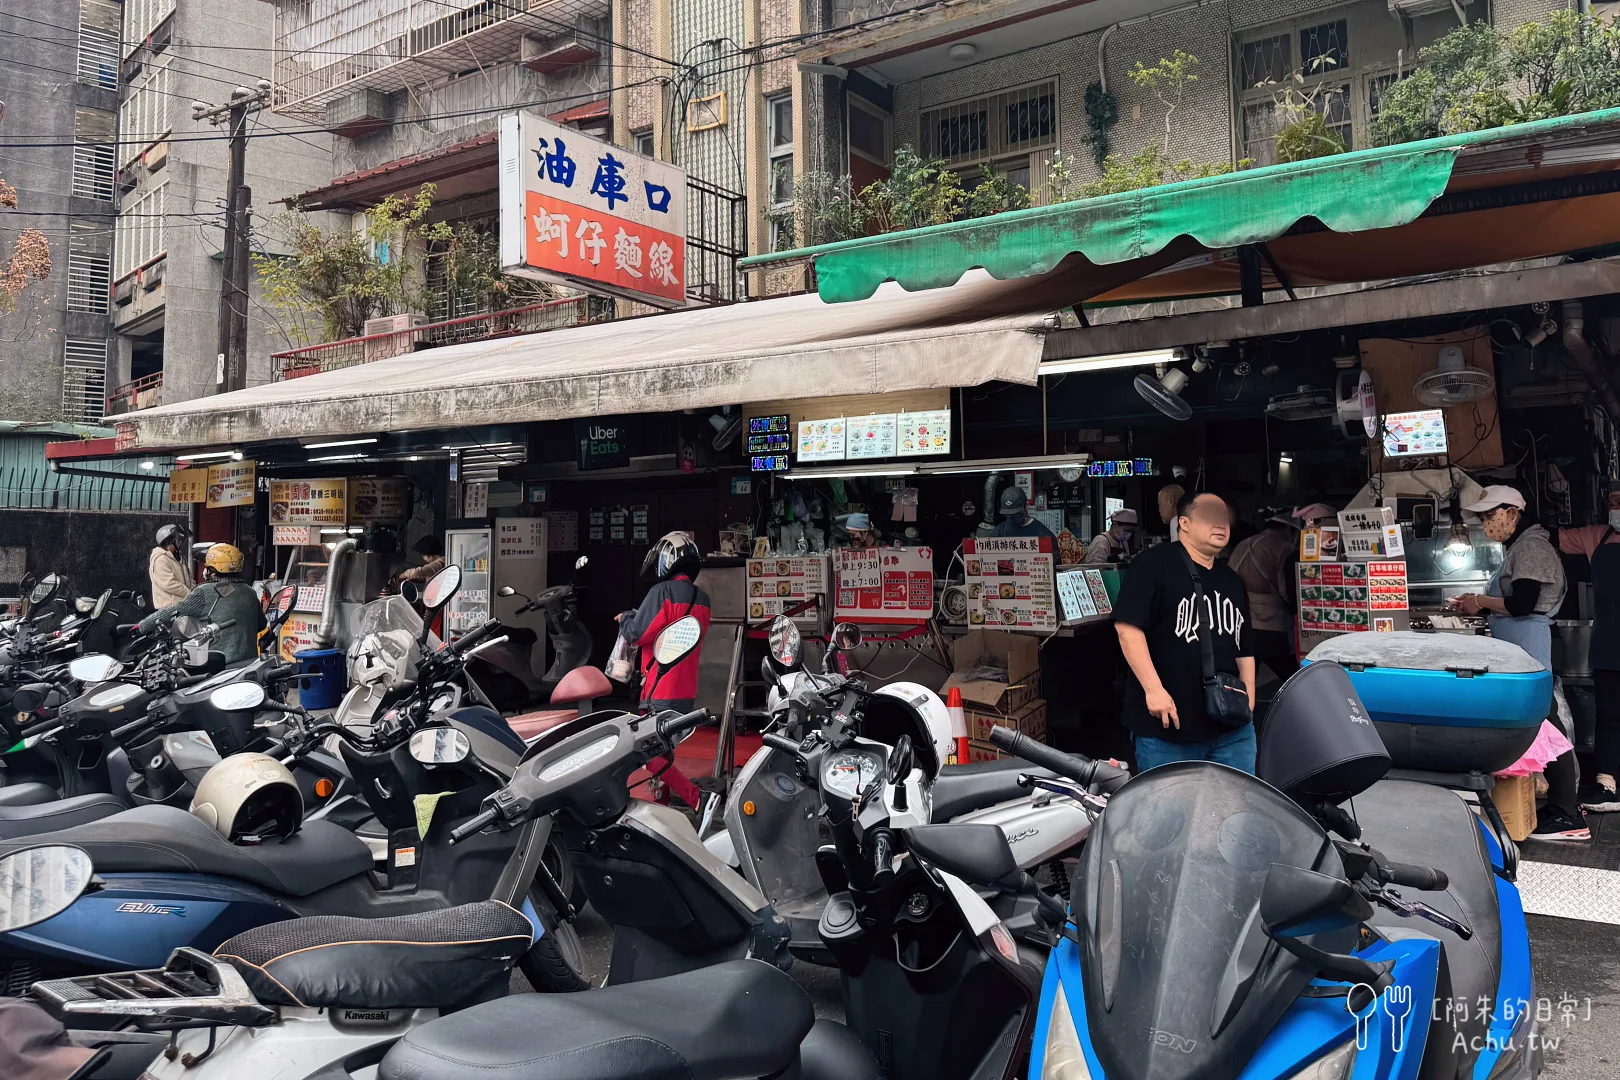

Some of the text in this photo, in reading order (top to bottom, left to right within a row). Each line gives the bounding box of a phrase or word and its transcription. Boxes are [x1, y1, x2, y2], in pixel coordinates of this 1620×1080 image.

[531, 137, 671, 214] 油庫口
[532, 206, 680, 287] 蚵仔麵線
[753, 419, 777, 431] 外帶區
[589, 426, 617, 440] Uber
[590, 441, 619, 455] Eats
[754, 457, 786, 469] 取餐區
[1091, 462, 1130, 475] 內用區
[976, 540, 1038, 551] 內用須排隊取餐
[842, 550, 876, 561] 營業時間
[344, 1010, 390, 1021] Kawasaki
